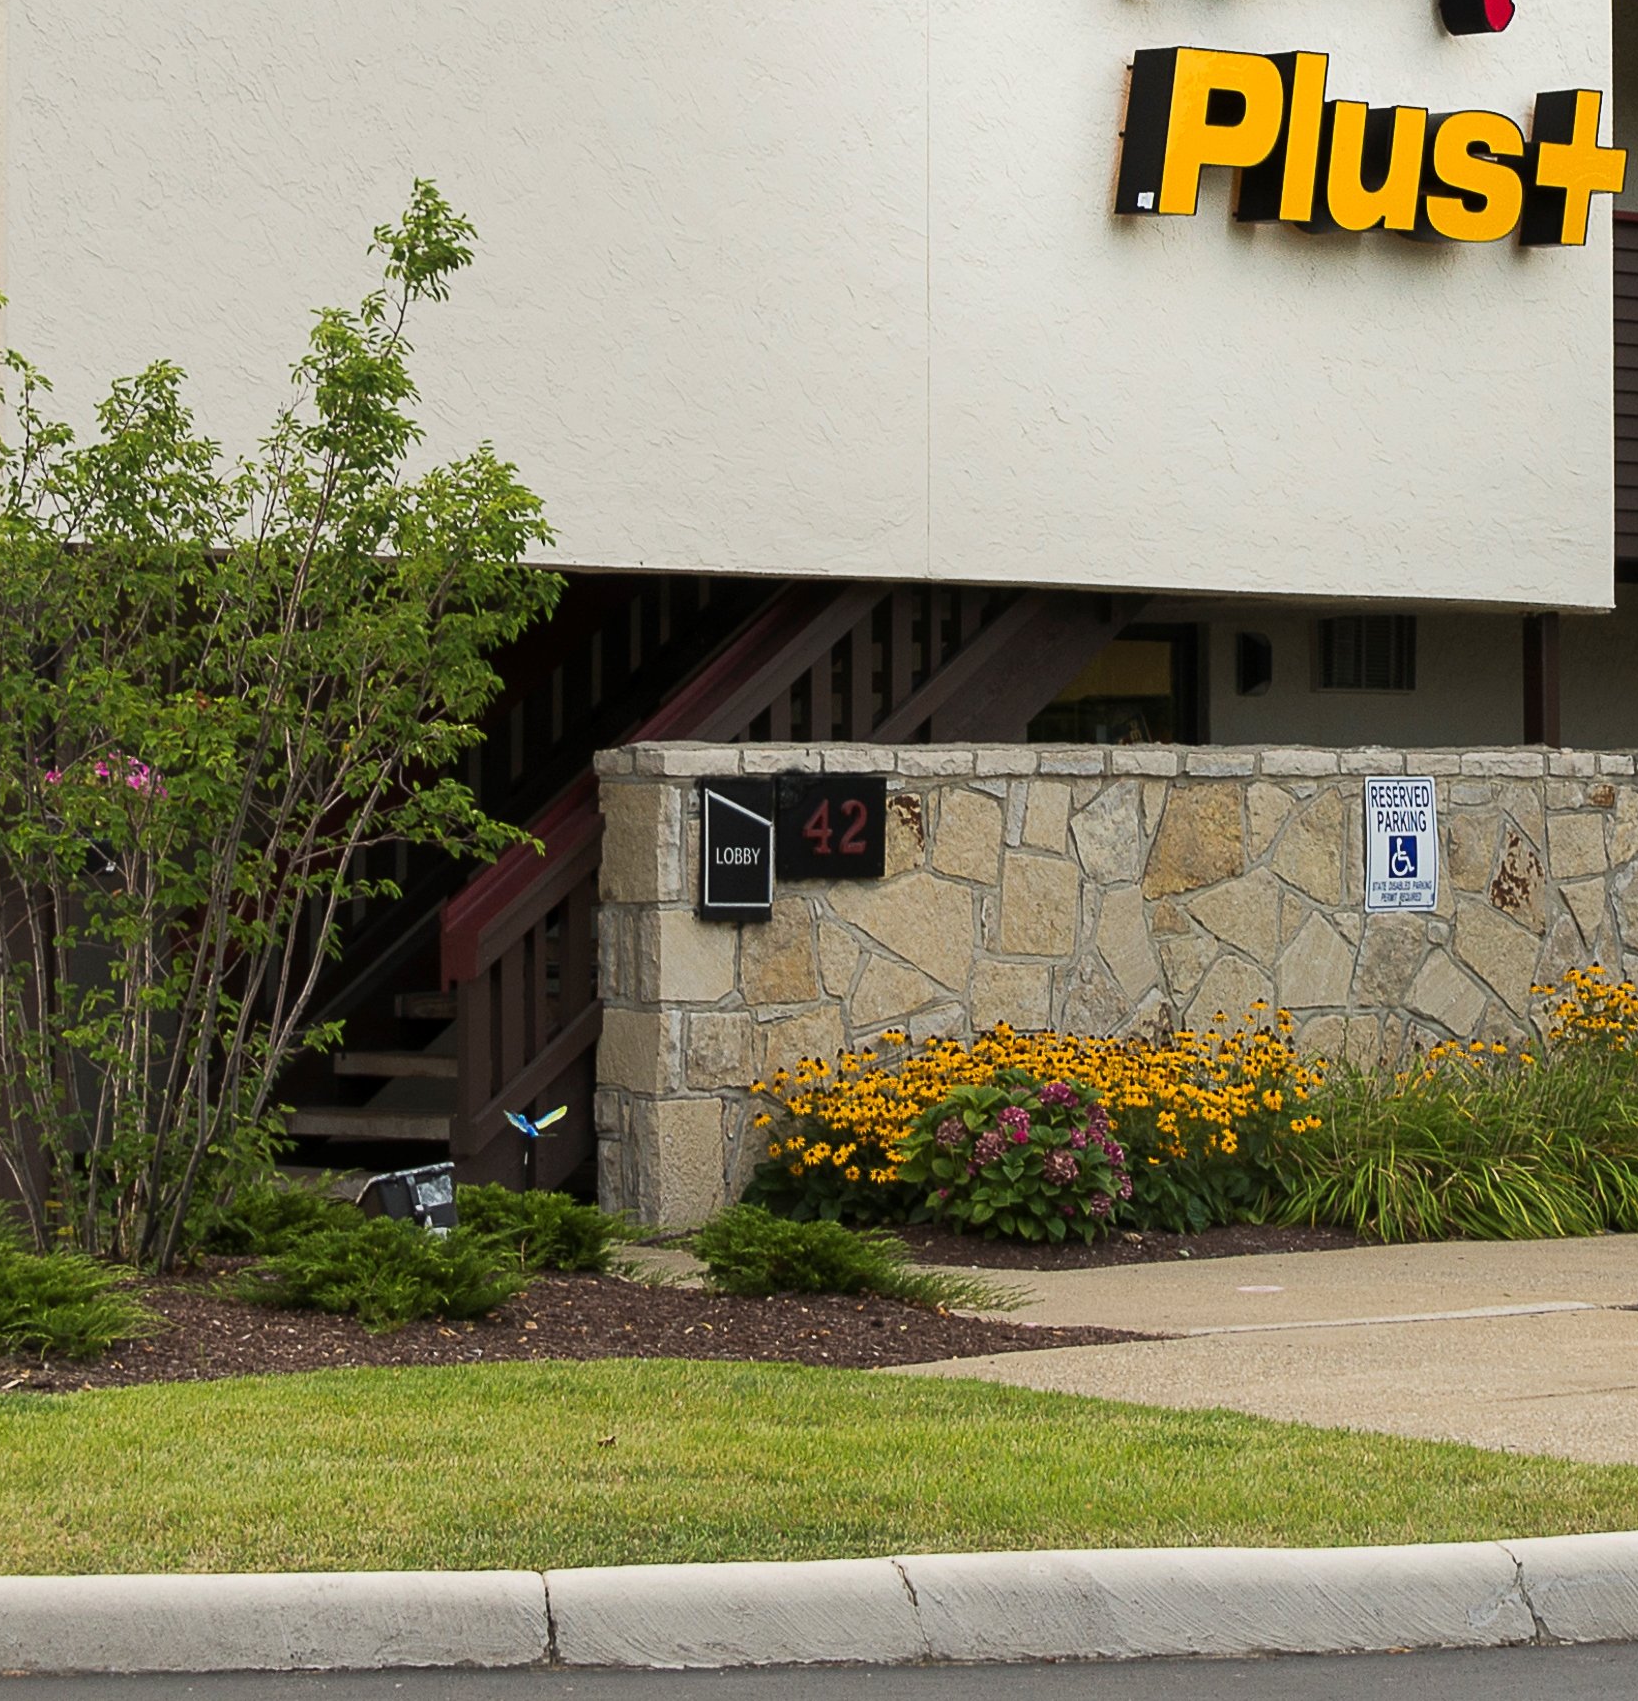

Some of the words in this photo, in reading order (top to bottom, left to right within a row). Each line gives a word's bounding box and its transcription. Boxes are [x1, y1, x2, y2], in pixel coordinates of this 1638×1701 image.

[1159, 46, 1627, 246] Plus+
[1371, 786, 1430, 808] RESERVED
[802, 797, 869, 855] 42
[1377, 811, 1427, 833] PARKING
[715, 847, 761, 865] LOBBY
[1373, 882, 1387, 892] STATE
[1389, 882, 1411, 891] DISABLED
[1413, 881, 1432, 891] PARKING
[1381, 893, 1397, 903] PERMIT
[1400, 892, 1422, 902] REQUIRED
